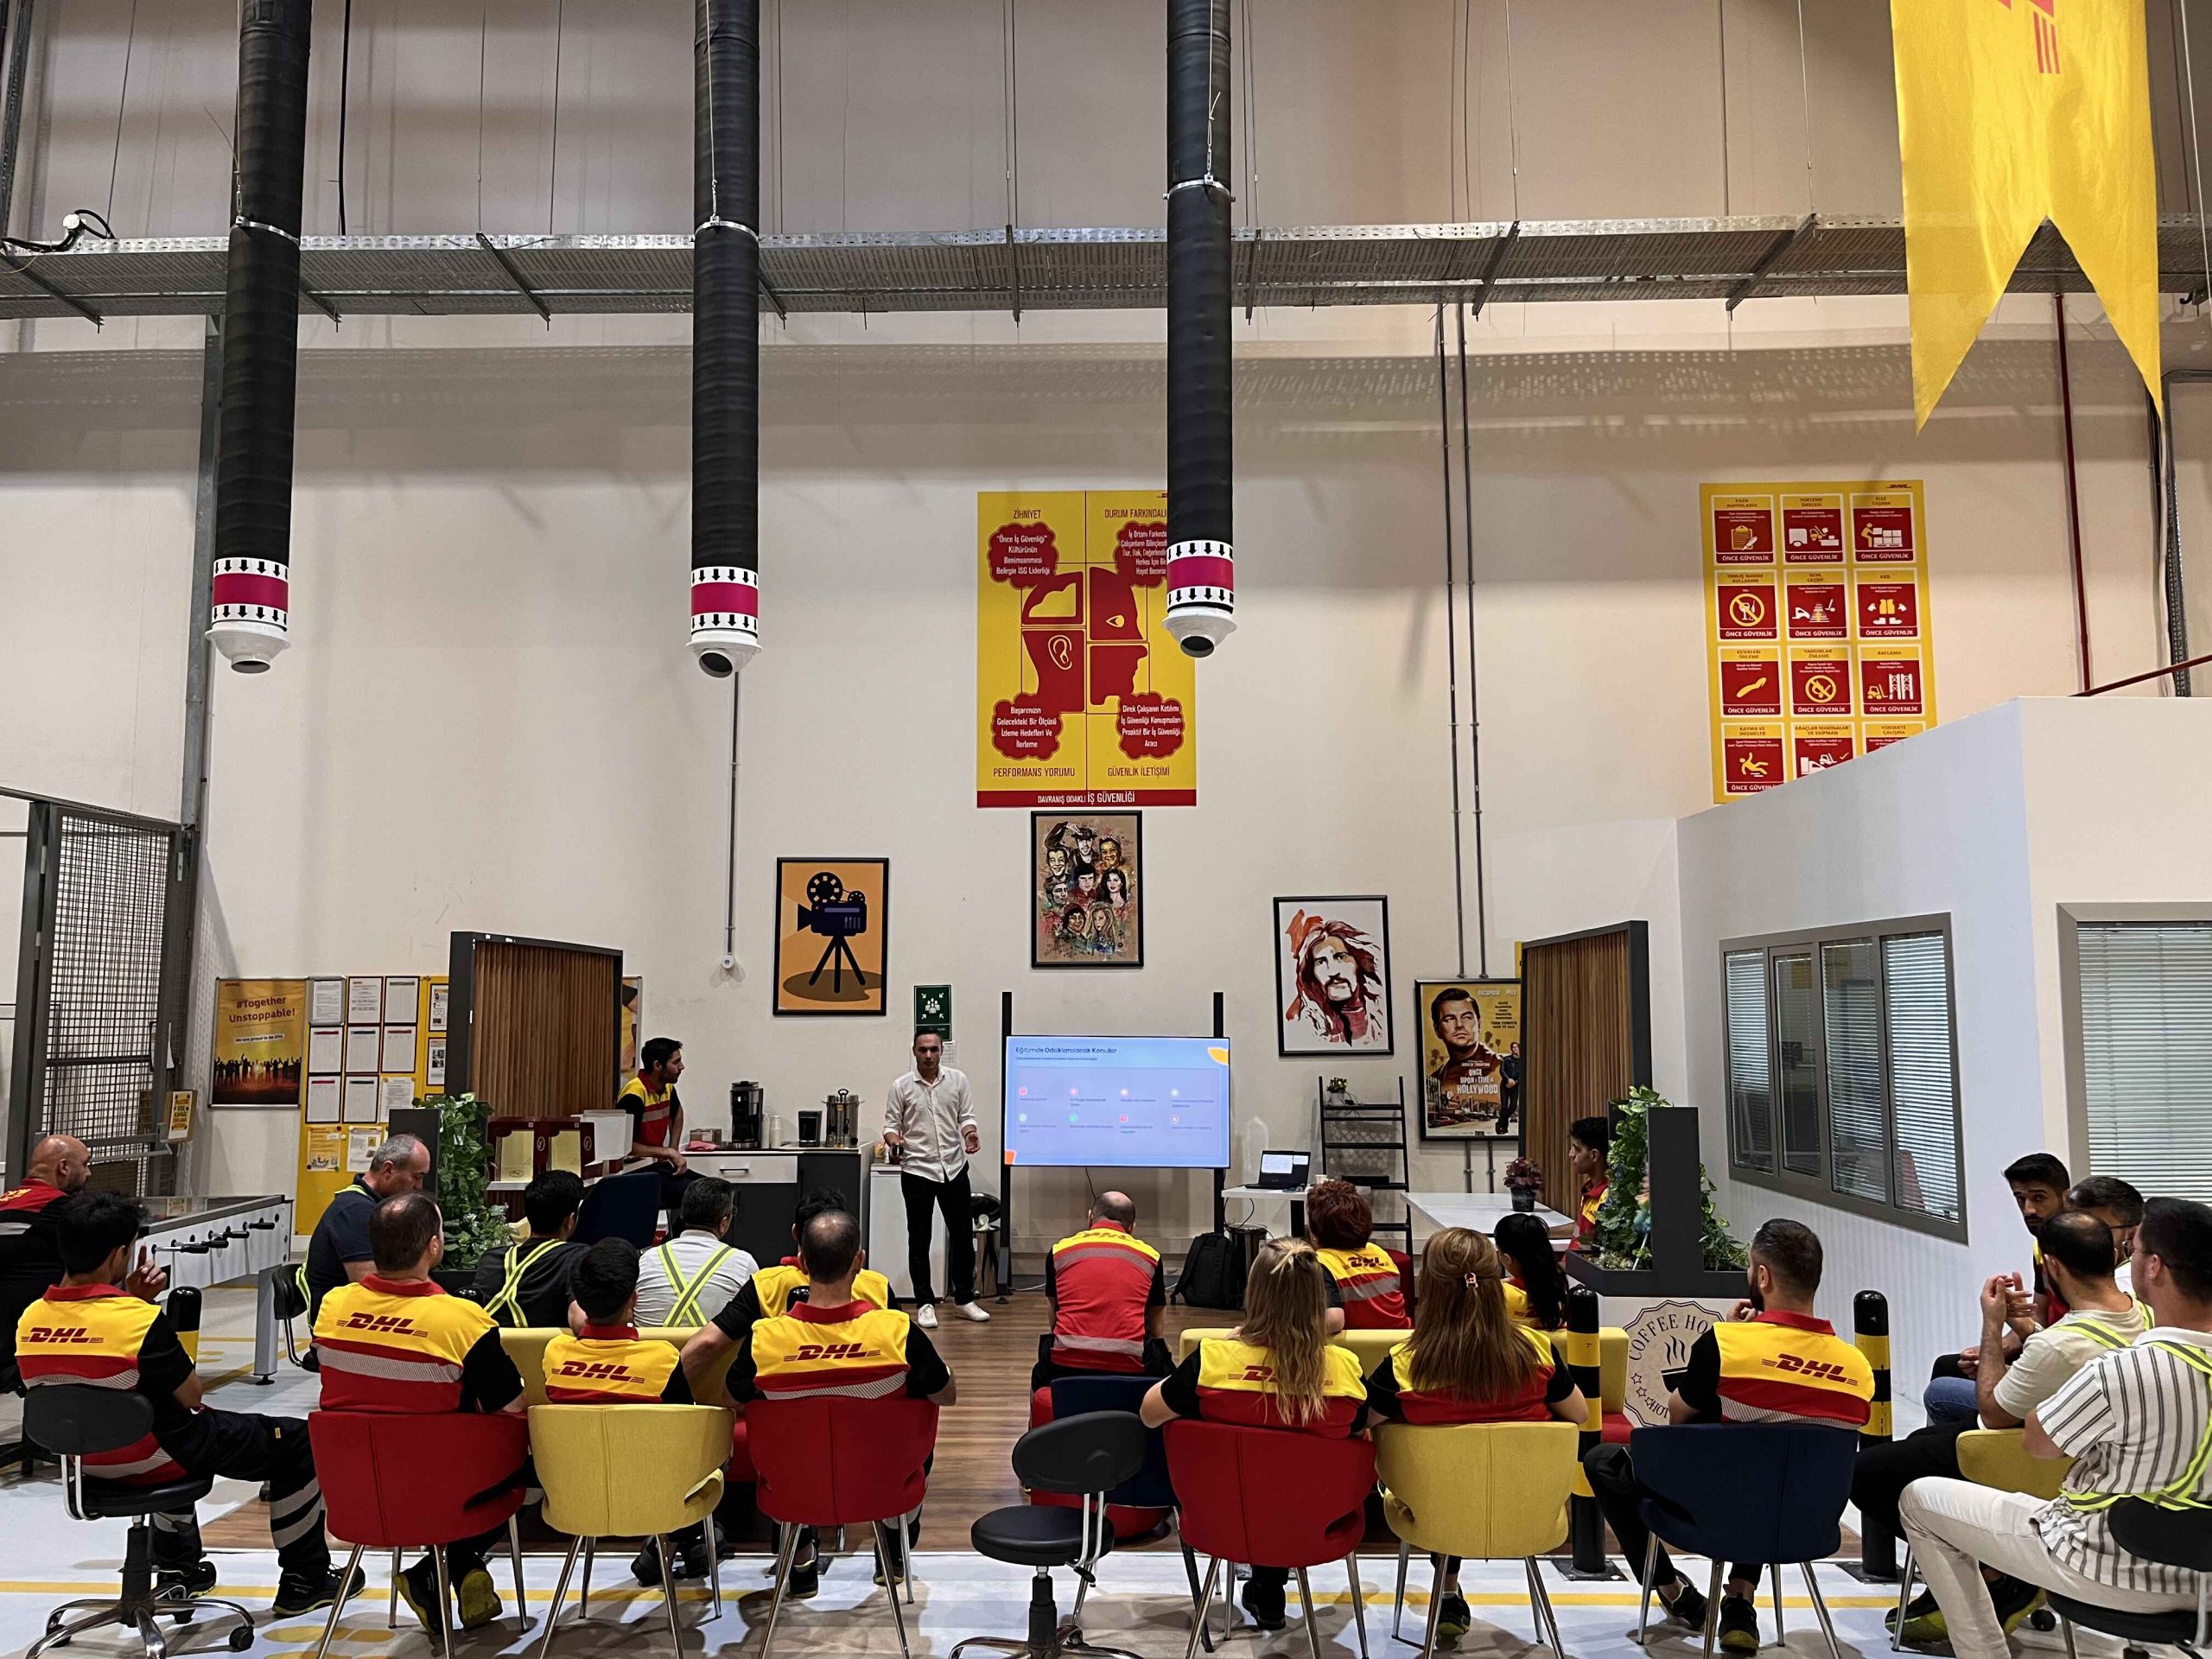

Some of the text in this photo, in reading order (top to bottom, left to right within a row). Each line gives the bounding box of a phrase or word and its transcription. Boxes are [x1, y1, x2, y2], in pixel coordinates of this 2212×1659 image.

[1014, 508, 1041, 518] ZİHNİYET
[1105, 509, 1166, 518] DURUM FARKINDALI
[1039, 716, 1057, 727] Ölçüsü
[993, 767, 1075, 777] PERFORMANS YORUMU
[1108, 765, 1170, 778] GÜVENLİK İLETİŞİMİ
[1038, 796, 1065, 804] DAVRANIŞ
[1087, 791, 1095, 804] İŞ
[1097, 791, 1135, 803] GÜVENLİĞİ
[237, 997, 287, 1008] #Together
[229, 1008, 296, 1022] Unstoppable!
[1457, 1084, 1498, 1094] HOLLYWOOD
[346, 1312, 416, 1335] DHL
[29, 1327, 91, 1344] DHL
[1629, 1313, 1709, 1361] COFFEE HO
[797, 1343, 868, 1361] DHL
[559, 1360, 632, 1382] DHL
[1776, 1353, 1847, 1383] DHL
